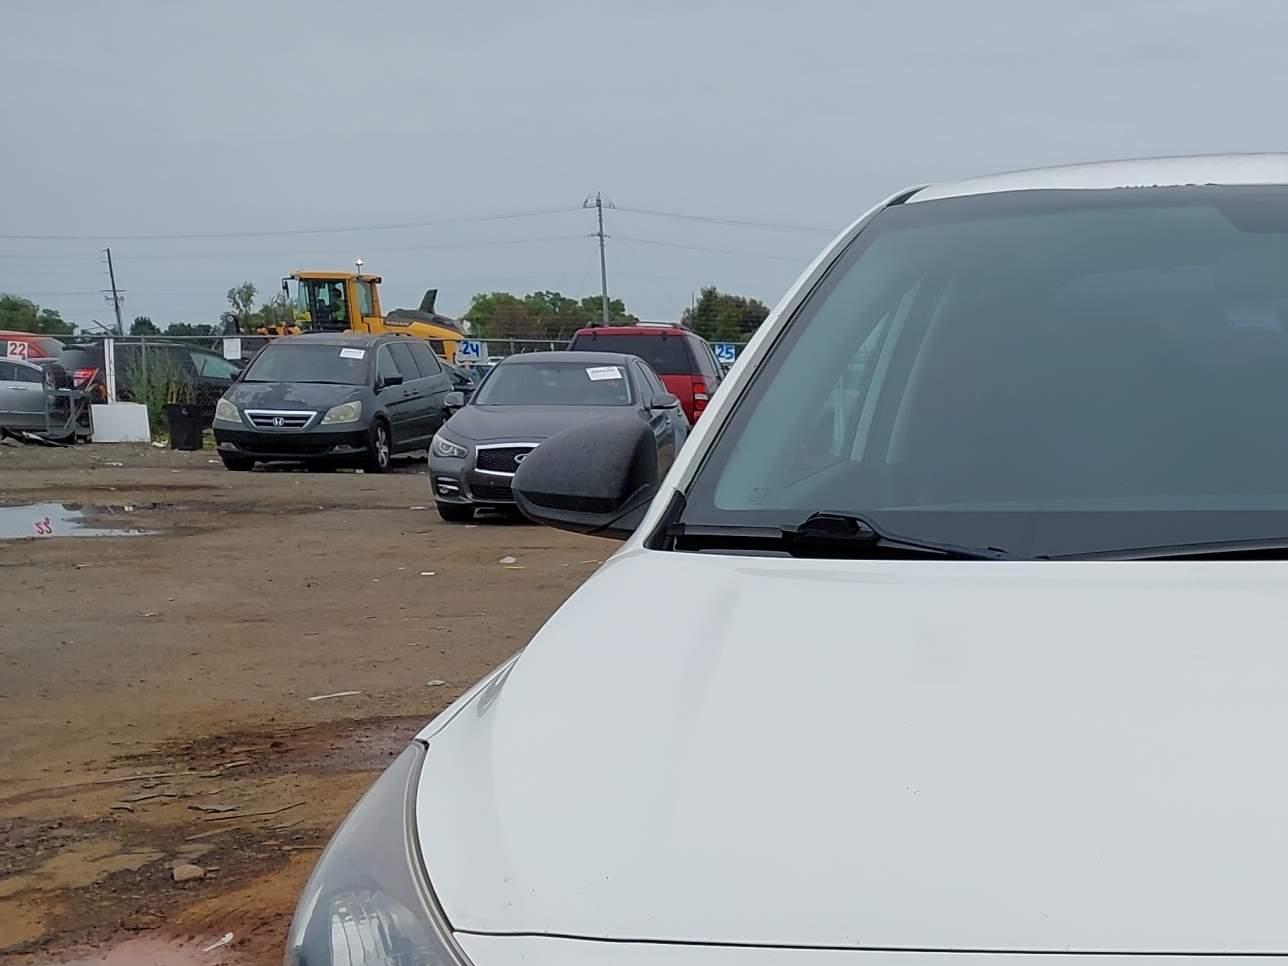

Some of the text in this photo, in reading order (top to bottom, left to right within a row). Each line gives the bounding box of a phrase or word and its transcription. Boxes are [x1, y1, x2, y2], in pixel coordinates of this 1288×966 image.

[9, 342, 26, 356] 22
[462, 341, 480, 358] 24
[716, 344, 734, 360] 25
